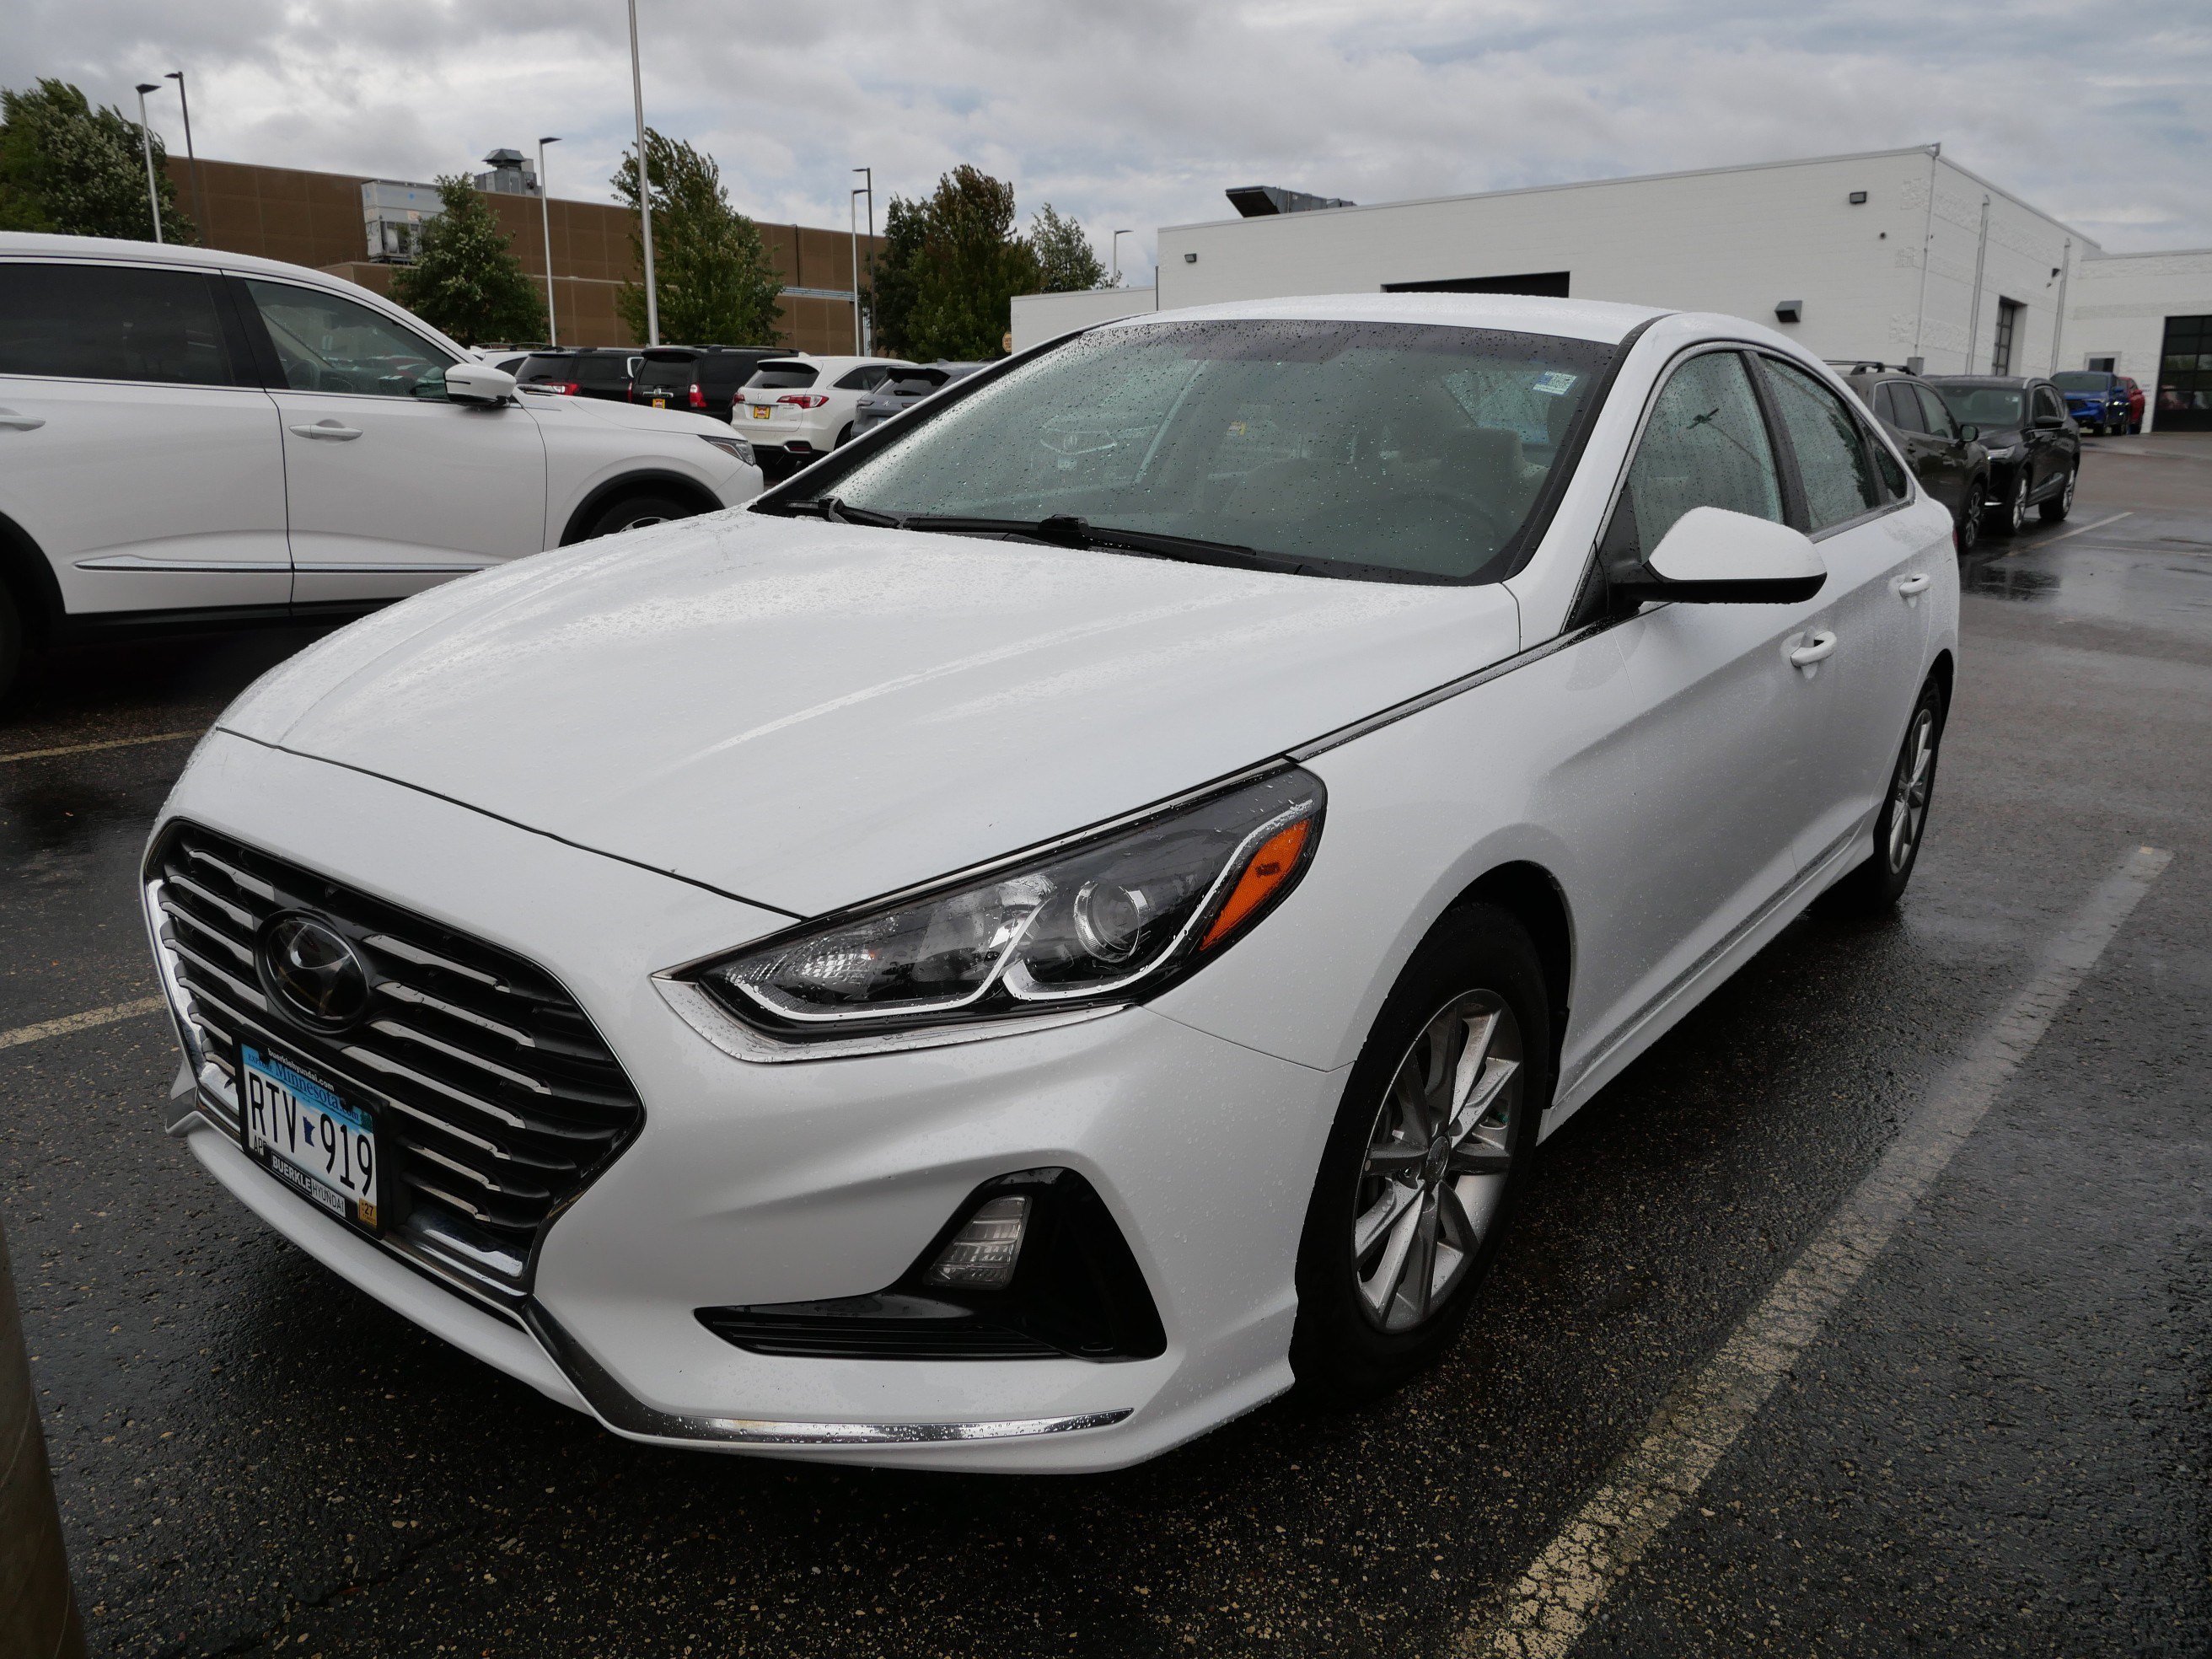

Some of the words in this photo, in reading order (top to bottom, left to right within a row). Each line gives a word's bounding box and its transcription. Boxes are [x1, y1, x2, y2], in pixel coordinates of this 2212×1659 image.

[267, 1048, 335, 1092] buerklehyundai.com
[249, 1071, 297, 1153] RTV
[320, 1114, 373, 1196] 919
[272, 1152, 312, 1194] BUERKLE
[312, 1180, 344, 1212] HYUNDAI
[364, 1202, 374, 1216] 27
